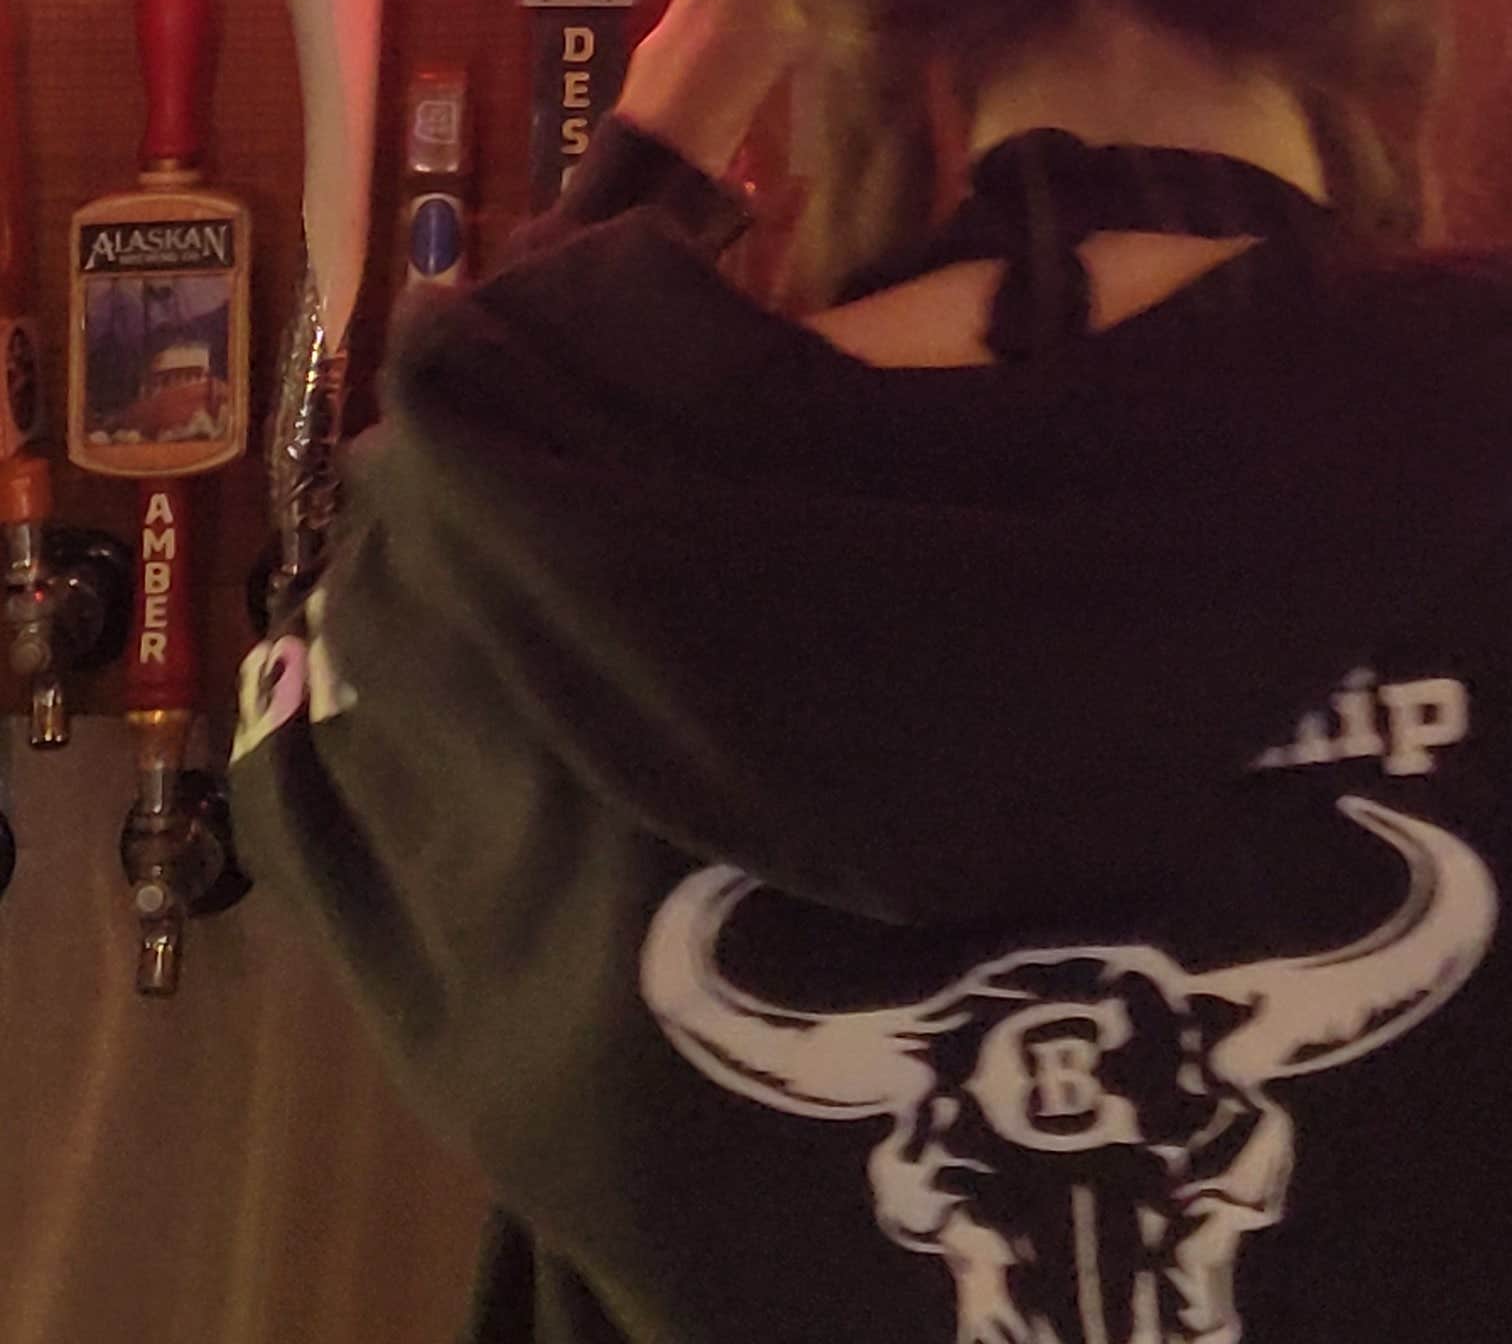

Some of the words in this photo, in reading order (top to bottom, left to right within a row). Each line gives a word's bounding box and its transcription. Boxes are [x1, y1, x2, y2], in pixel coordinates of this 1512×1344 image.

[560, 26, 596, 192] DES
[84, 215, 228, 270] ALASKAN
[139, 493, 176, 664] AMBER
